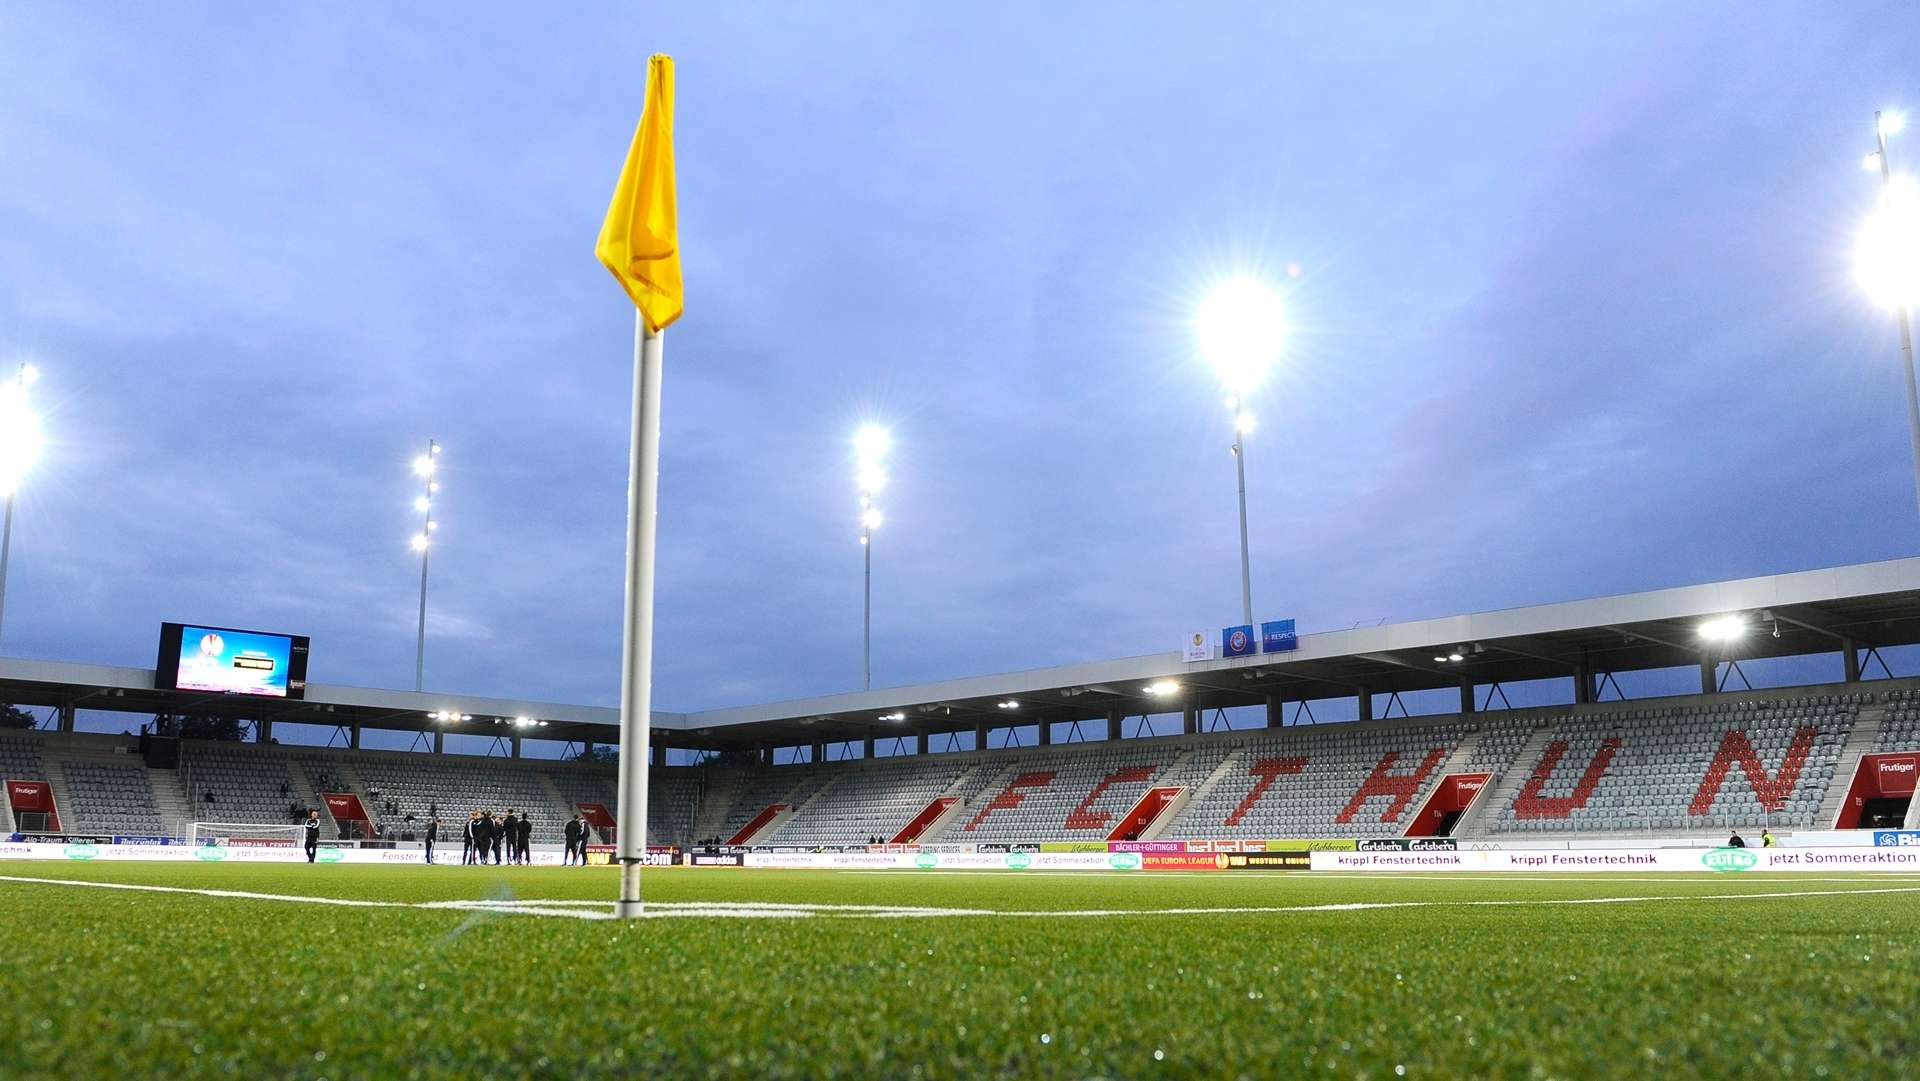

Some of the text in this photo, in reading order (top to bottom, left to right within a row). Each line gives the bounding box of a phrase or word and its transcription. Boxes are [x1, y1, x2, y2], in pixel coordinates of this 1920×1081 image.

[1880, 763, 1914, 772] Frutiger
[1224, 726, 1818, 826] THUN
[1409, 839, 1455, 851] Carlsberg
[1898, 833, 1920, 846] Bi
[1358, 840, 1402, 851] Carlsberg
[1143, 857, 1160, 865] UEFA
[1161, 857, 1187, 865] EUROPA
[1188, 857, 1215, 865] LEAGUE
[1249, 857, 1283, 865] WESTERN
[1286, 857, 1310, 865] UNION
[1338, 855, 1461, 866] krippl Fenstertechnik
[1511, 854, 1657, 866] krippl Fenstertechnik
[1769, 851, 1917, 866] jetzt Sommeraktion
